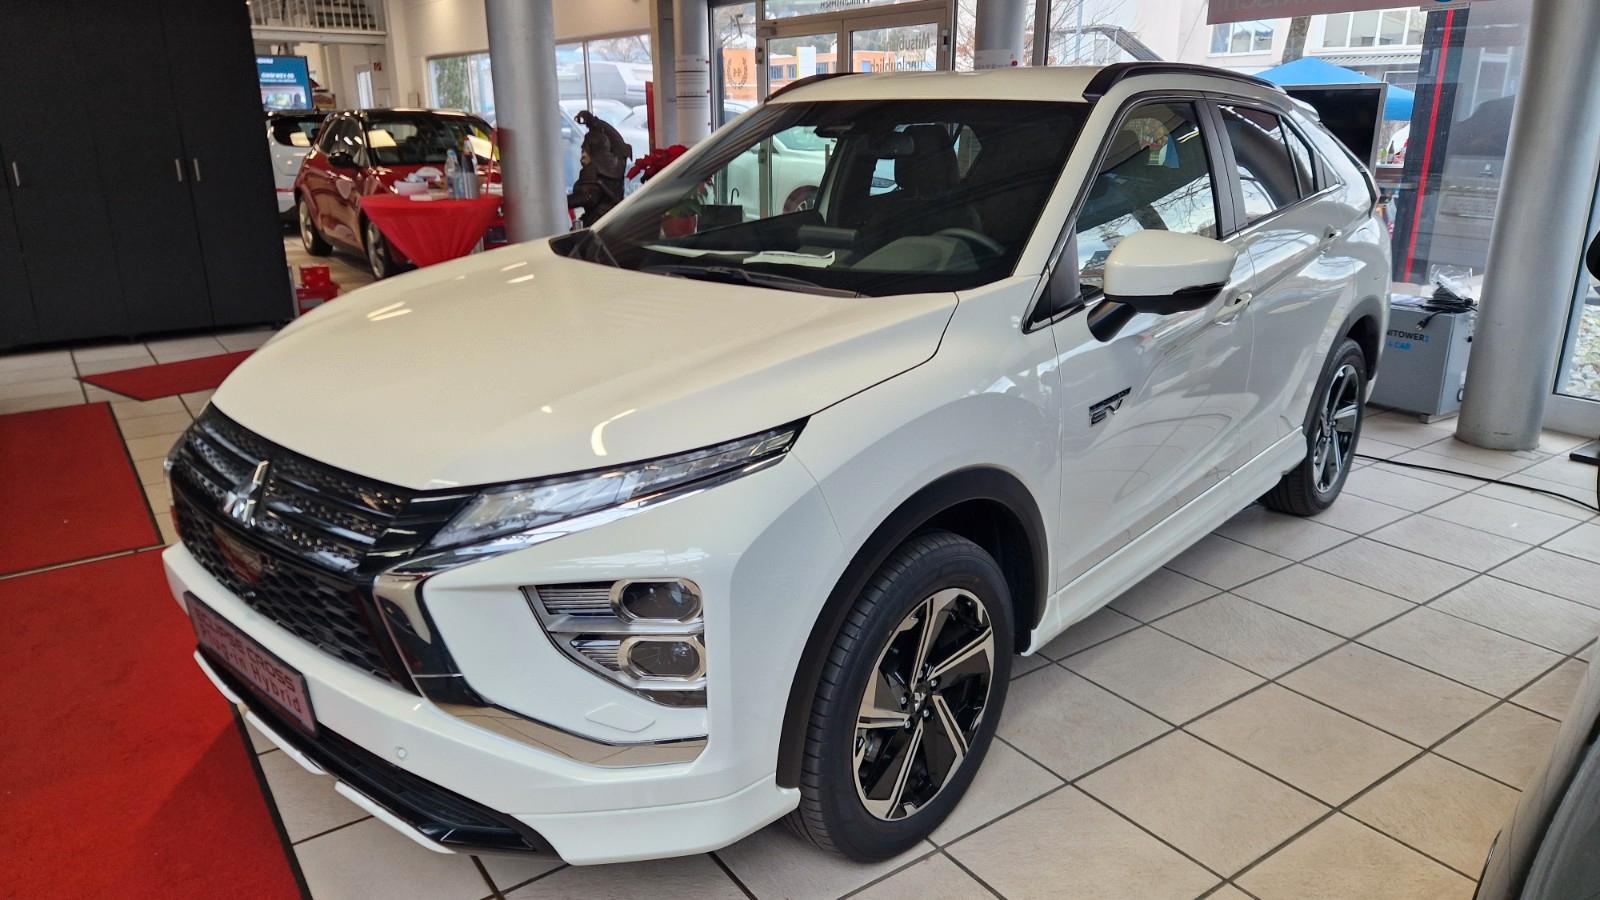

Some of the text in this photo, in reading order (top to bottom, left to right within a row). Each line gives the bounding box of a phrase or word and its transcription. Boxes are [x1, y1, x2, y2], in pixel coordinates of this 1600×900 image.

[1091, 399, 1124, 427] EV
[193, 607, 295, 692] ECLIPSE CROSS
[250, 663, 302, 714] Hybrid
